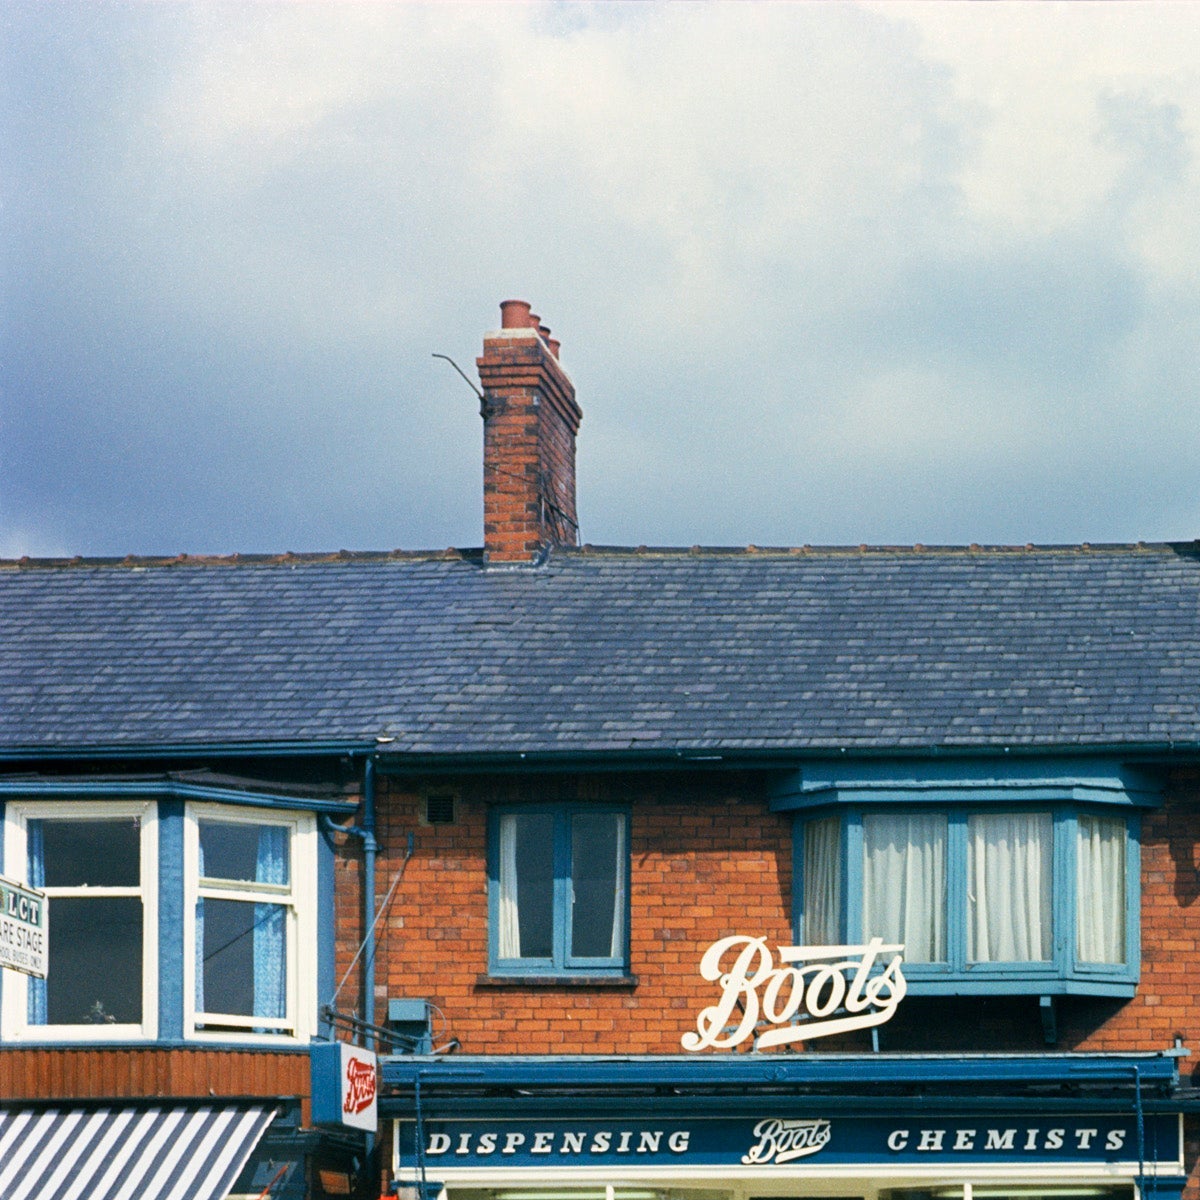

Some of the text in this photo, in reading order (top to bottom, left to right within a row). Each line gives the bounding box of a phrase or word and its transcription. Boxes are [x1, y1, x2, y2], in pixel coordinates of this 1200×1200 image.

[8, 891, 39, 925] LCT
[0, 921, 42, 954] RE STAGE
[681, 934, 907, 1052] Boots
[343, 1056, 376, 1115] Boots
[426, 1118, 1127, 1165] DISPENSING Boots CHEMISTS
